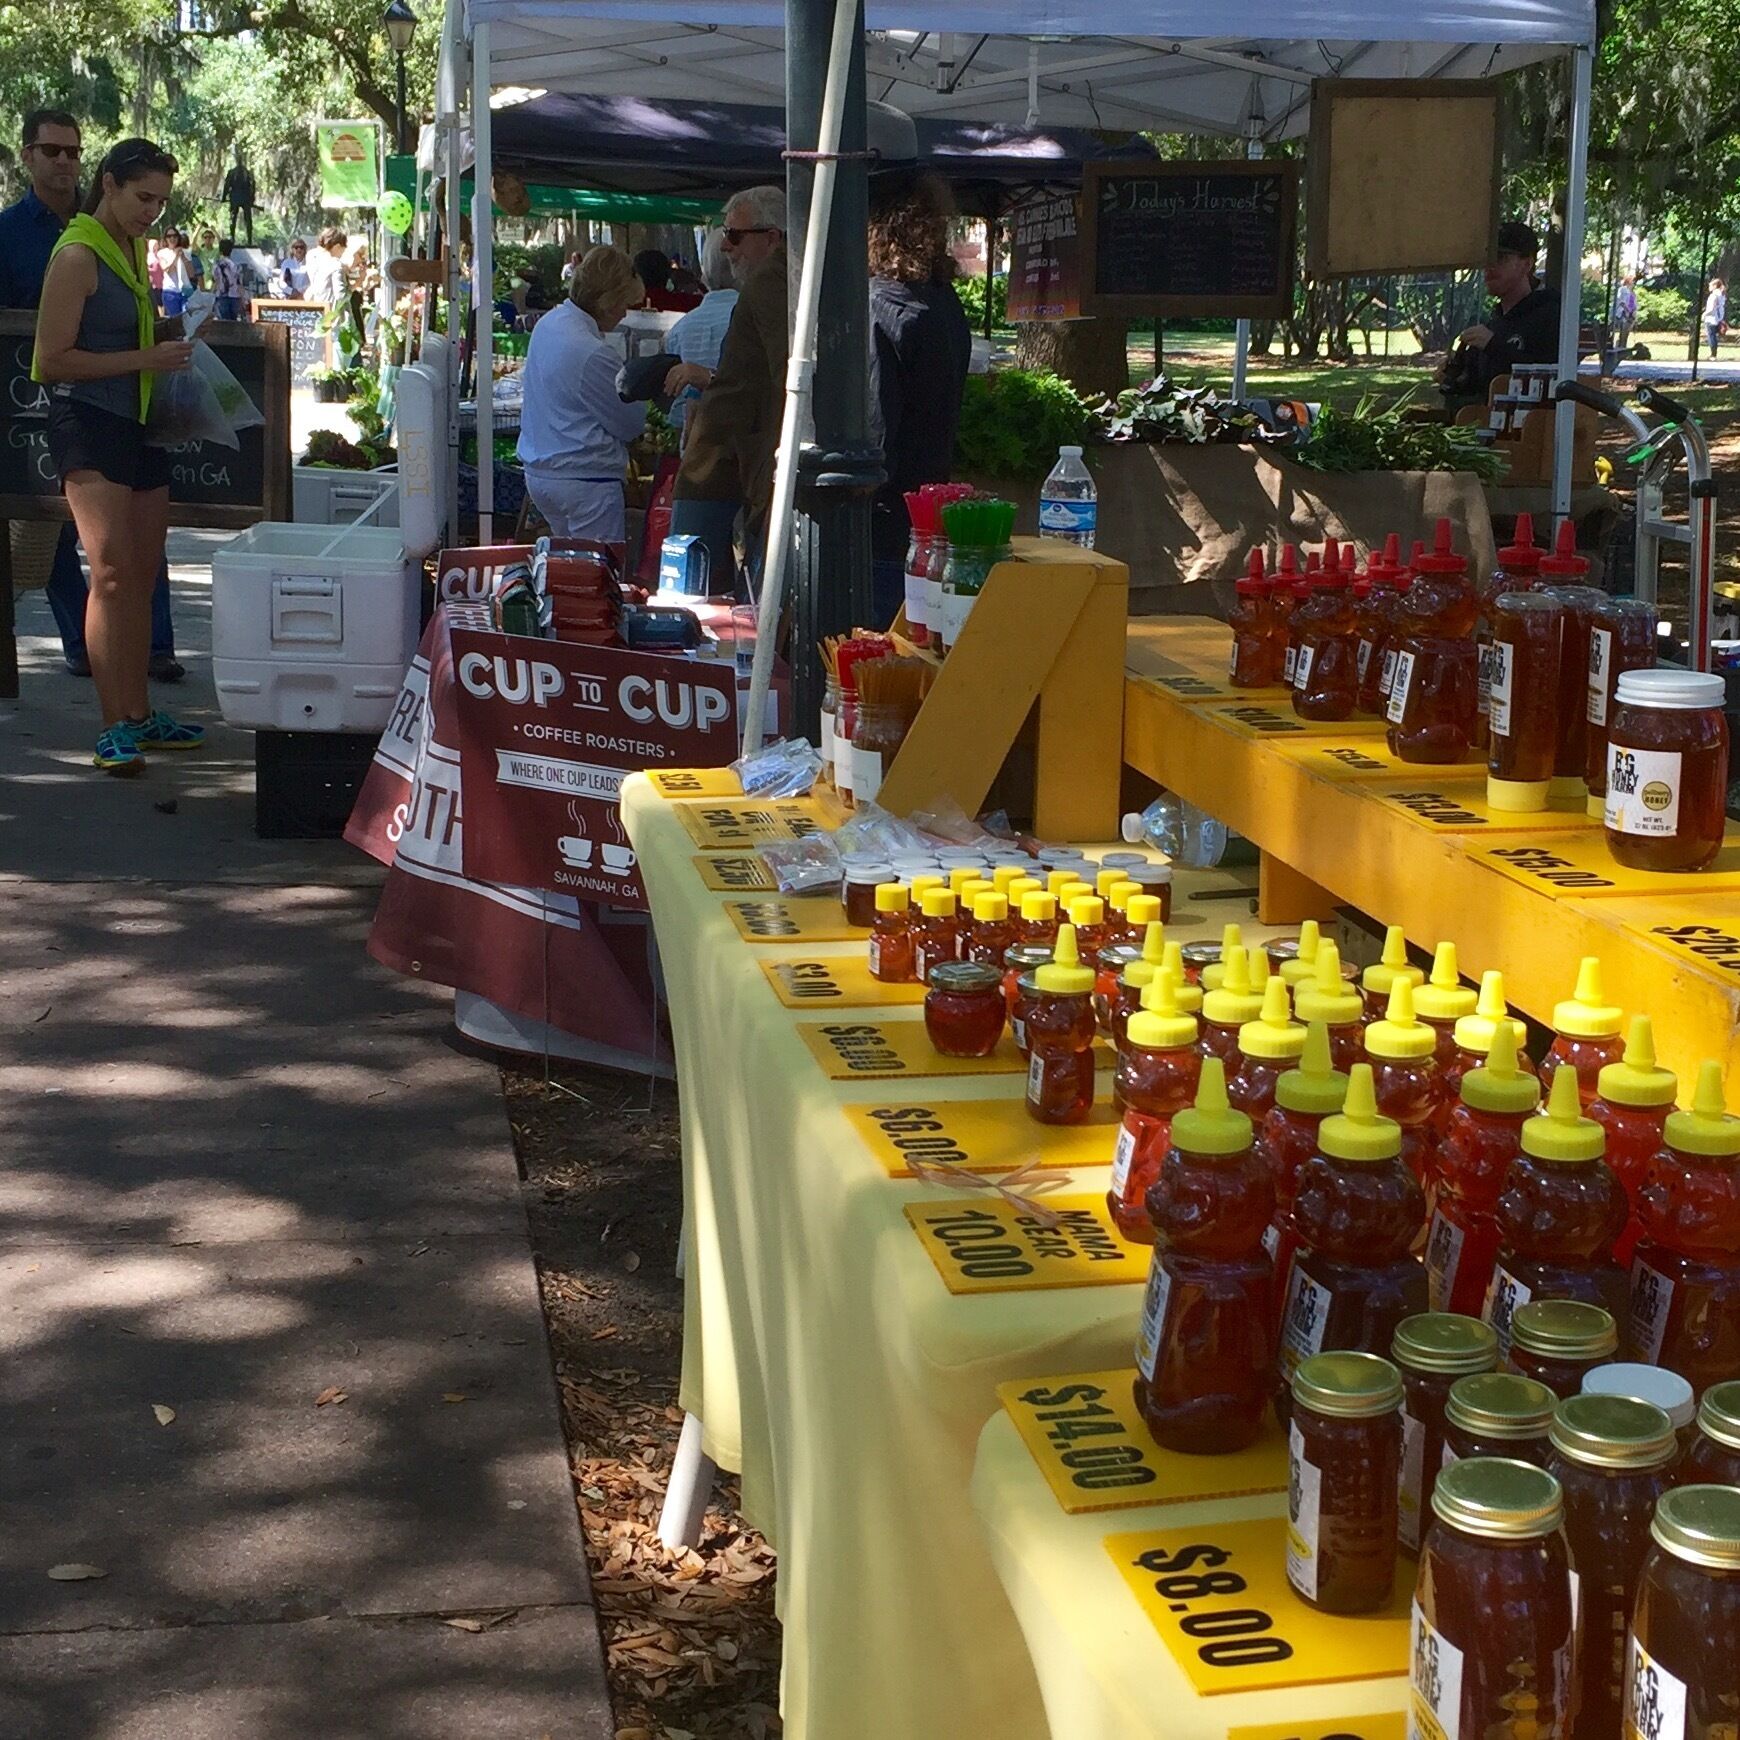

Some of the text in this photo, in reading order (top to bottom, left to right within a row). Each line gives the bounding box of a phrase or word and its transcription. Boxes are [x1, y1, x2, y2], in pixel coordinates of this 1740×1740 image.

[1123, 179, 1260, 219] Today's Harvest
[459, 651, 732, 734] CUP TO CUP
[523, 722, 666, 760] COFFEE ROASTERS
[509, 760, 619, 794] WHERE ONE CUP LEADS
[700, 808, 742, 828] FOR
[553, 870, 640, 899] SAVANNAH, GA
[1488, 847, 1617, 888] $15.00
[866, 1107, 968, 1164] $6.00
[924, 1209, 1035, 1279] 10.00
[1055, 1209, 1126, 1261] MAMA
[1016, 1383, 1158, 1490] $14.00
[1131, 1543, 1295, 1668] $8.00
